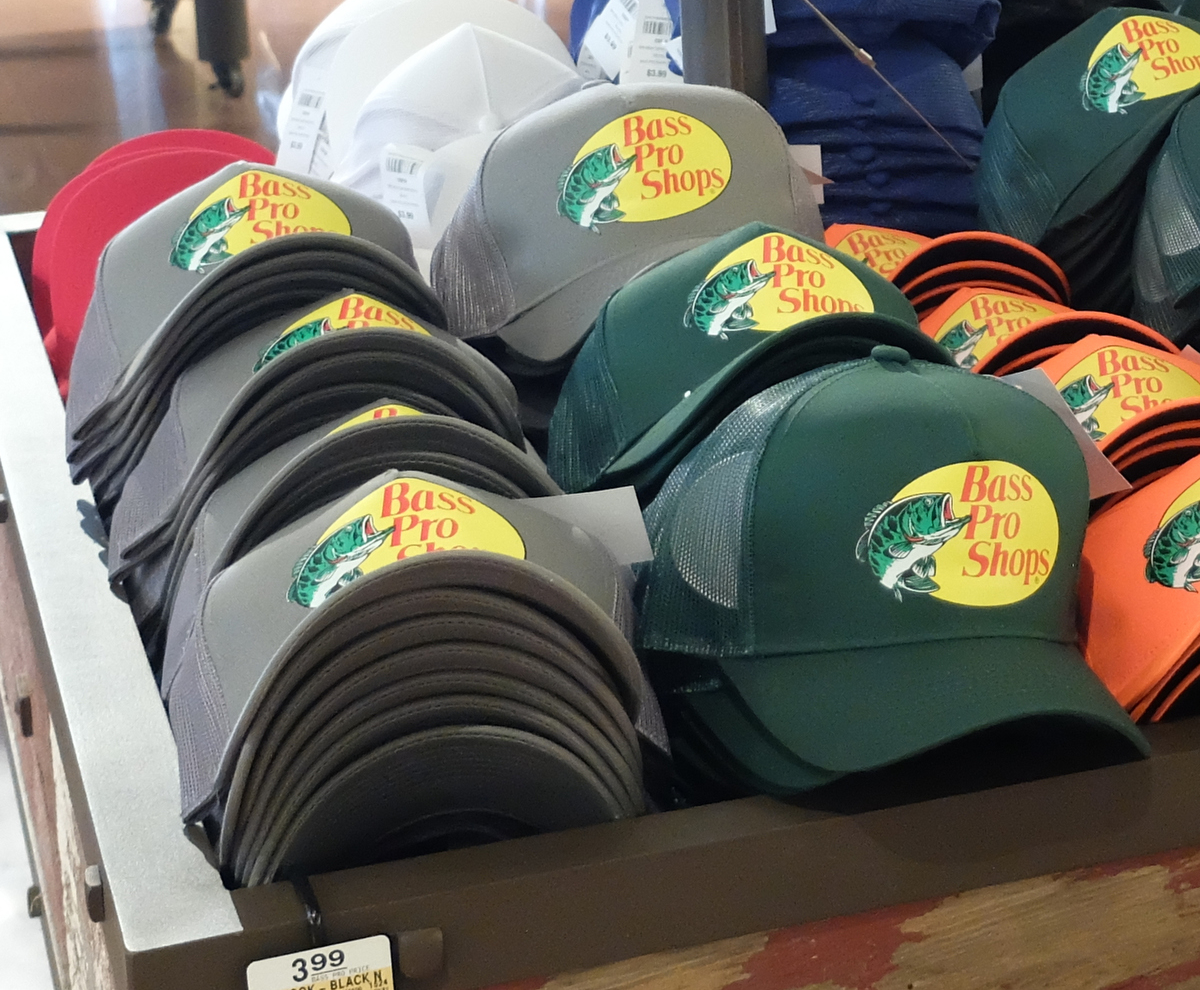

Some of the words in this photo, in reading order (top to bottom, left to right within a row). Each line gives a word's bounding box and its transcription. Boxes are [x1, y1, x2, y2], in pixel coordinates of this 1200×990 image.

[1122, 18, 1180, 44] Bass
[1137, 37, 1180, 61] Pro
[623, 115, 692, 147] Bass
[634, 143, 684, 173] Pro
[239, 172, 312, 200] Bass
[641, 168, 724, 200] Shops
[247, 198, 300, 221] Pro
[762, 235, 835, 269] Bass
[846, 232, 908, 255] Bass
[864, 247, 907, 268] Pro
[772, 263, 825, 288] Pro
[338, 296, 415, 331] Bass
[970, 296, 1038, 320] Bass
[985, 316, 1032, 337] Pro
[1097, 349, 1170, 376] Bass
[1110, 373, 1163, 398] Pro
[959, 464, 1033, 503] Bass
[381, 482, 476, 518] Bass
[390, 514, 459, 547] Pro
[963, 504, 1021, 540] Pro
[962, 541, 1050, 585] Shops
[292, 949, 345, 982] 399
[330, 972, 370, 990] BLACK
